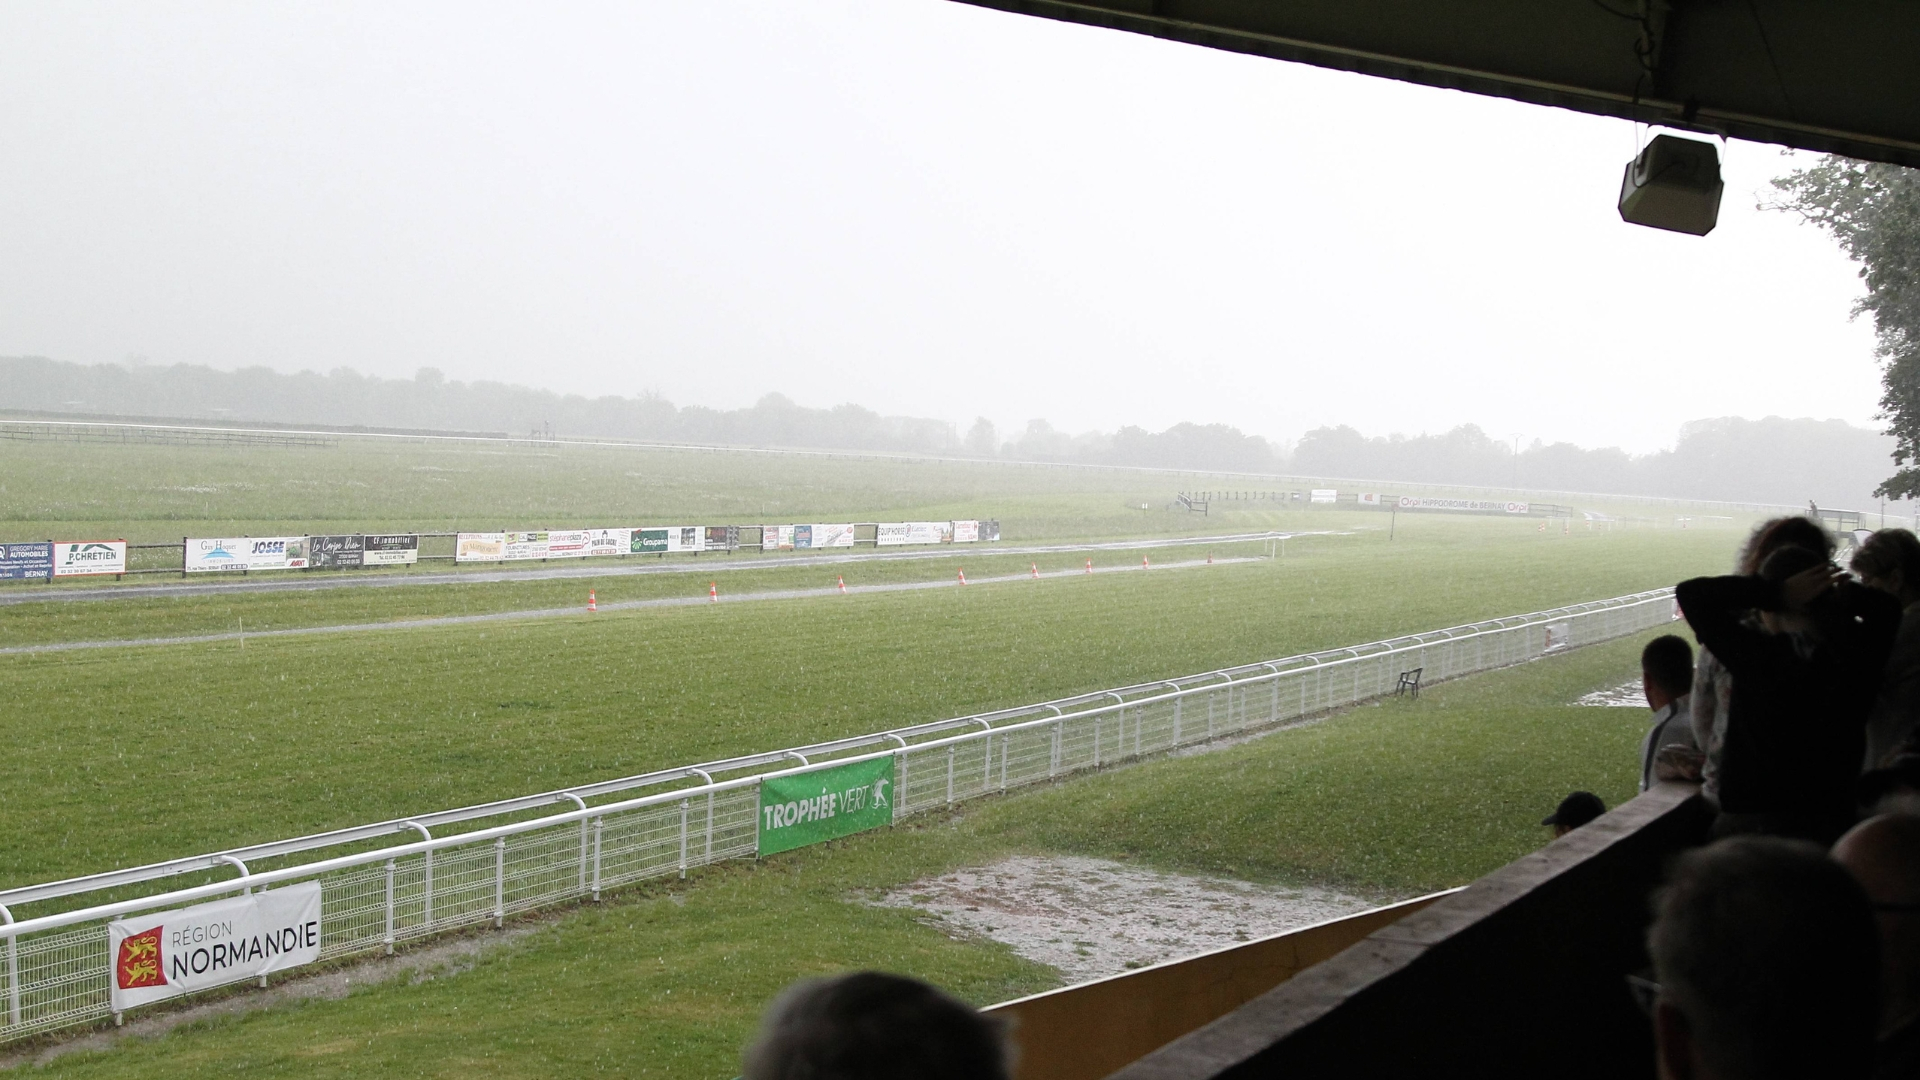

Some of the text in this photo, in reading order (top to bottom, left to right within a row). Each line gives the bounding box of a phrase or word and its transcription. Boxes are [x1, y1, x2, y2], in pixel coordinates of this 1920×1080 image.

[1401, 498, 1420, 508] Orpi
[1422, 499, 1468, 508] HIPPODROME
[1479, 503, 1506, 511] BERNAY
[1507, 502, 1528, 513] Orpi
[201, 540, 213, 551] Guy
[252, 541, 285, 554] JOSSE
[643, 538, 668, 547] Groupama
[69, 550, 117, 562] P.CHRÉTIEN
[25, 570, 48, 578] BERNAY
[764, 785, 869, 831] TROPHÉE VERT
[172, 920, 232, 948] RÉGION
[172, 921, 318, 980] NORMANDIE
